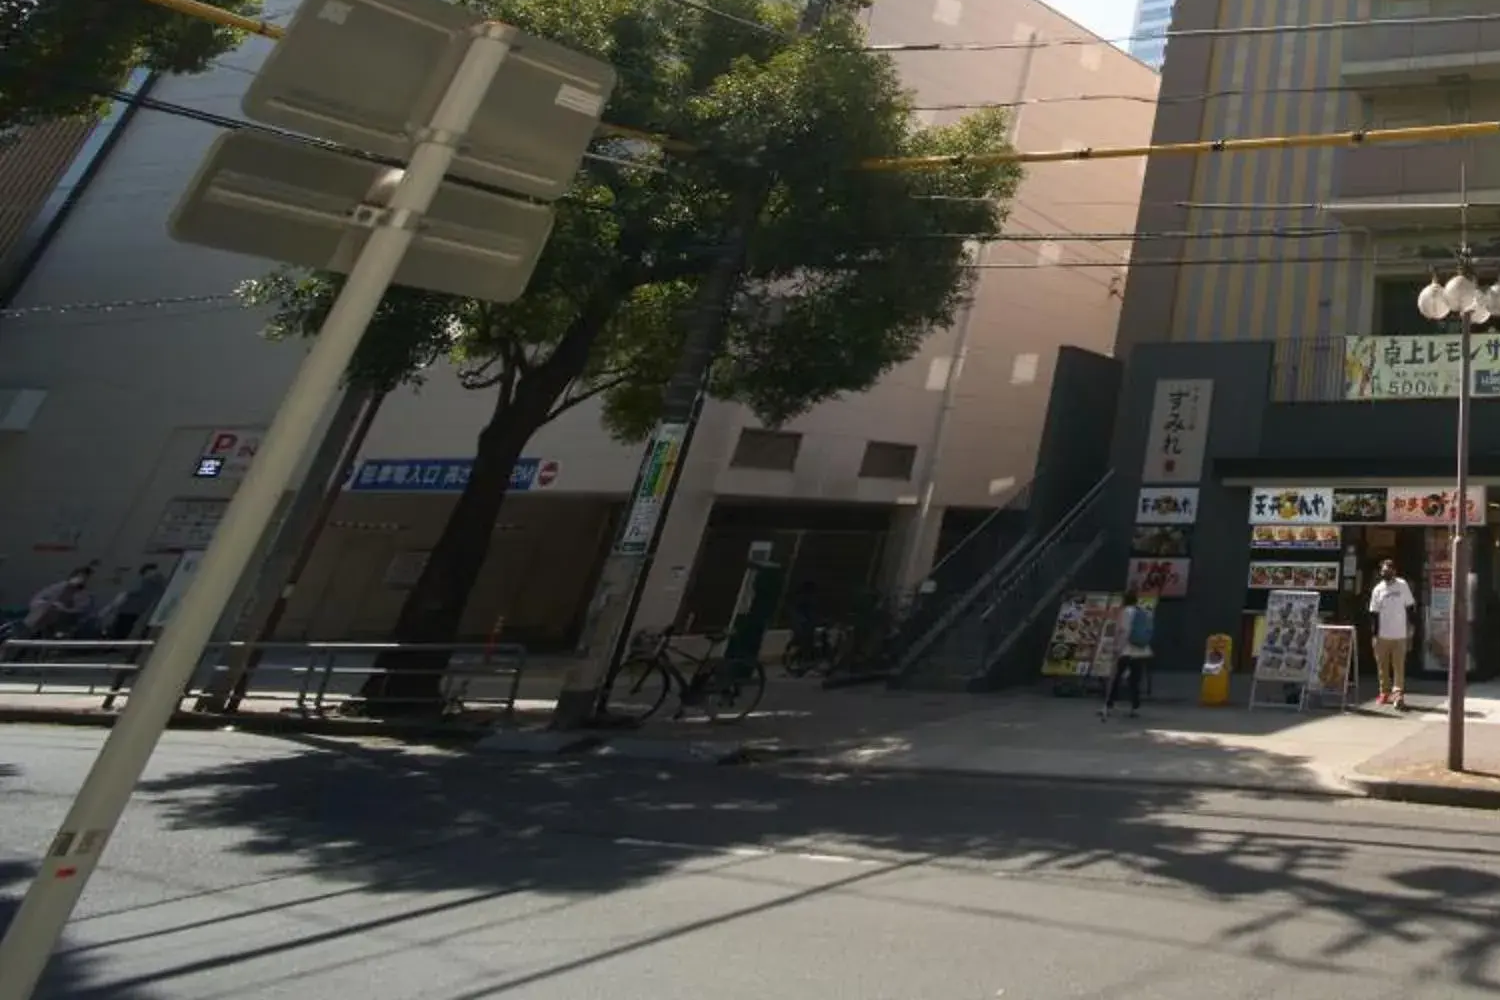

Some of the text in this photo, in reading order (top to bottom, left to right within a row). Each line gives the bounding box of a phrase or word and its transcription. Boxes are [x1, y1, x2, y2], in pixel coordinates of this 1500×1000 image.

[1162, 389, 1191, 455] すみれ
[211, 434, 238, 454] P
